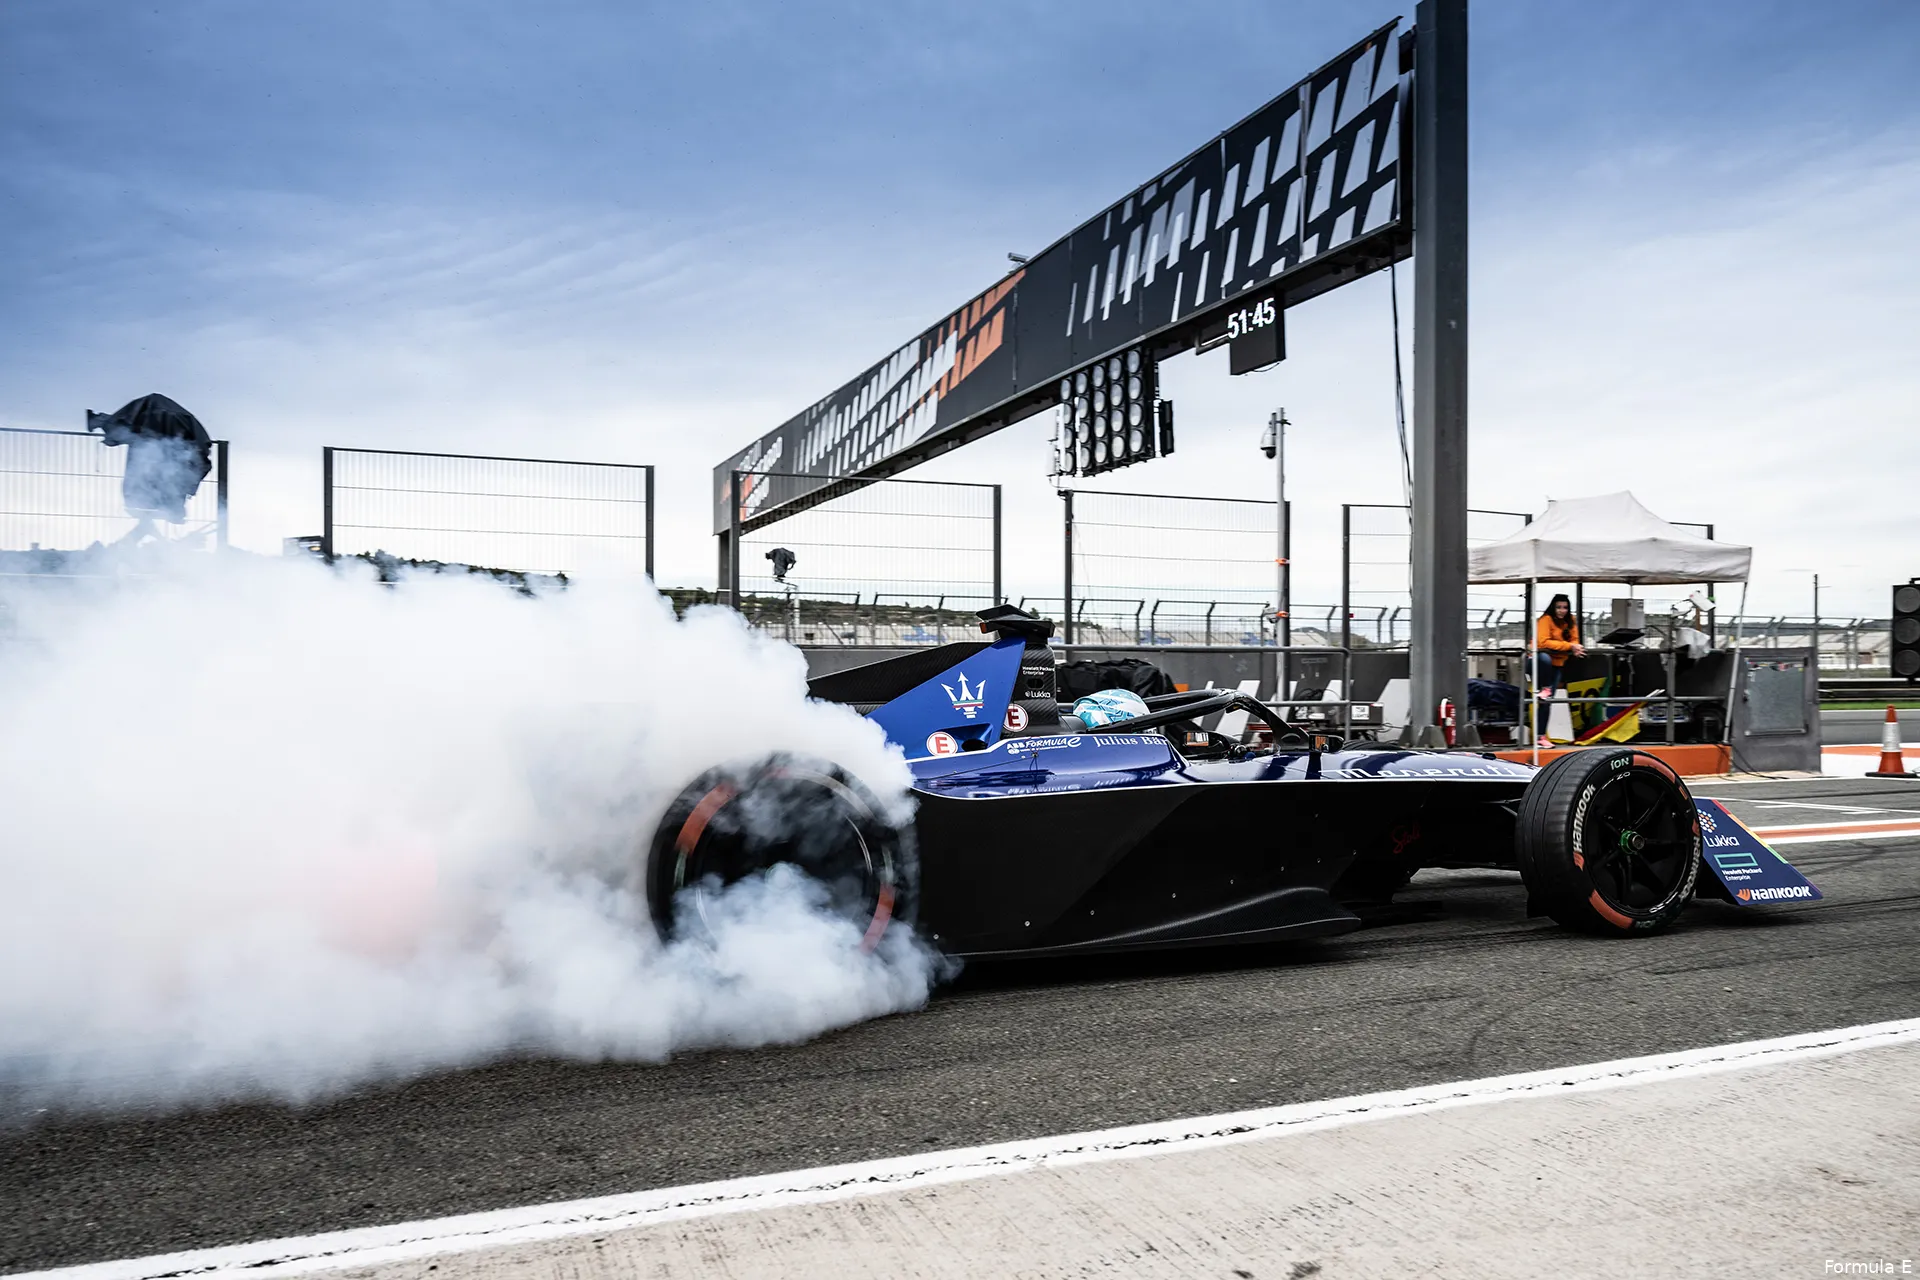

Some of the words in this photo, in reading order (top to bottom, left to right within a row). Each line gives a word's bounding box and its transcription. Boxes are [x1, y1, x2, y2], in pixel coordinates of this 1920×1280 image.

[1227, 297, 1276, 339] 51:45
[1007, 709, 1021, 727] E
[935, 737, 950, 753] E
[1026, 738, 1067, 748] FORMULA
[1093, 736, 1138, 748] Julius
[1703, 834, 1740, 847] Lukka
